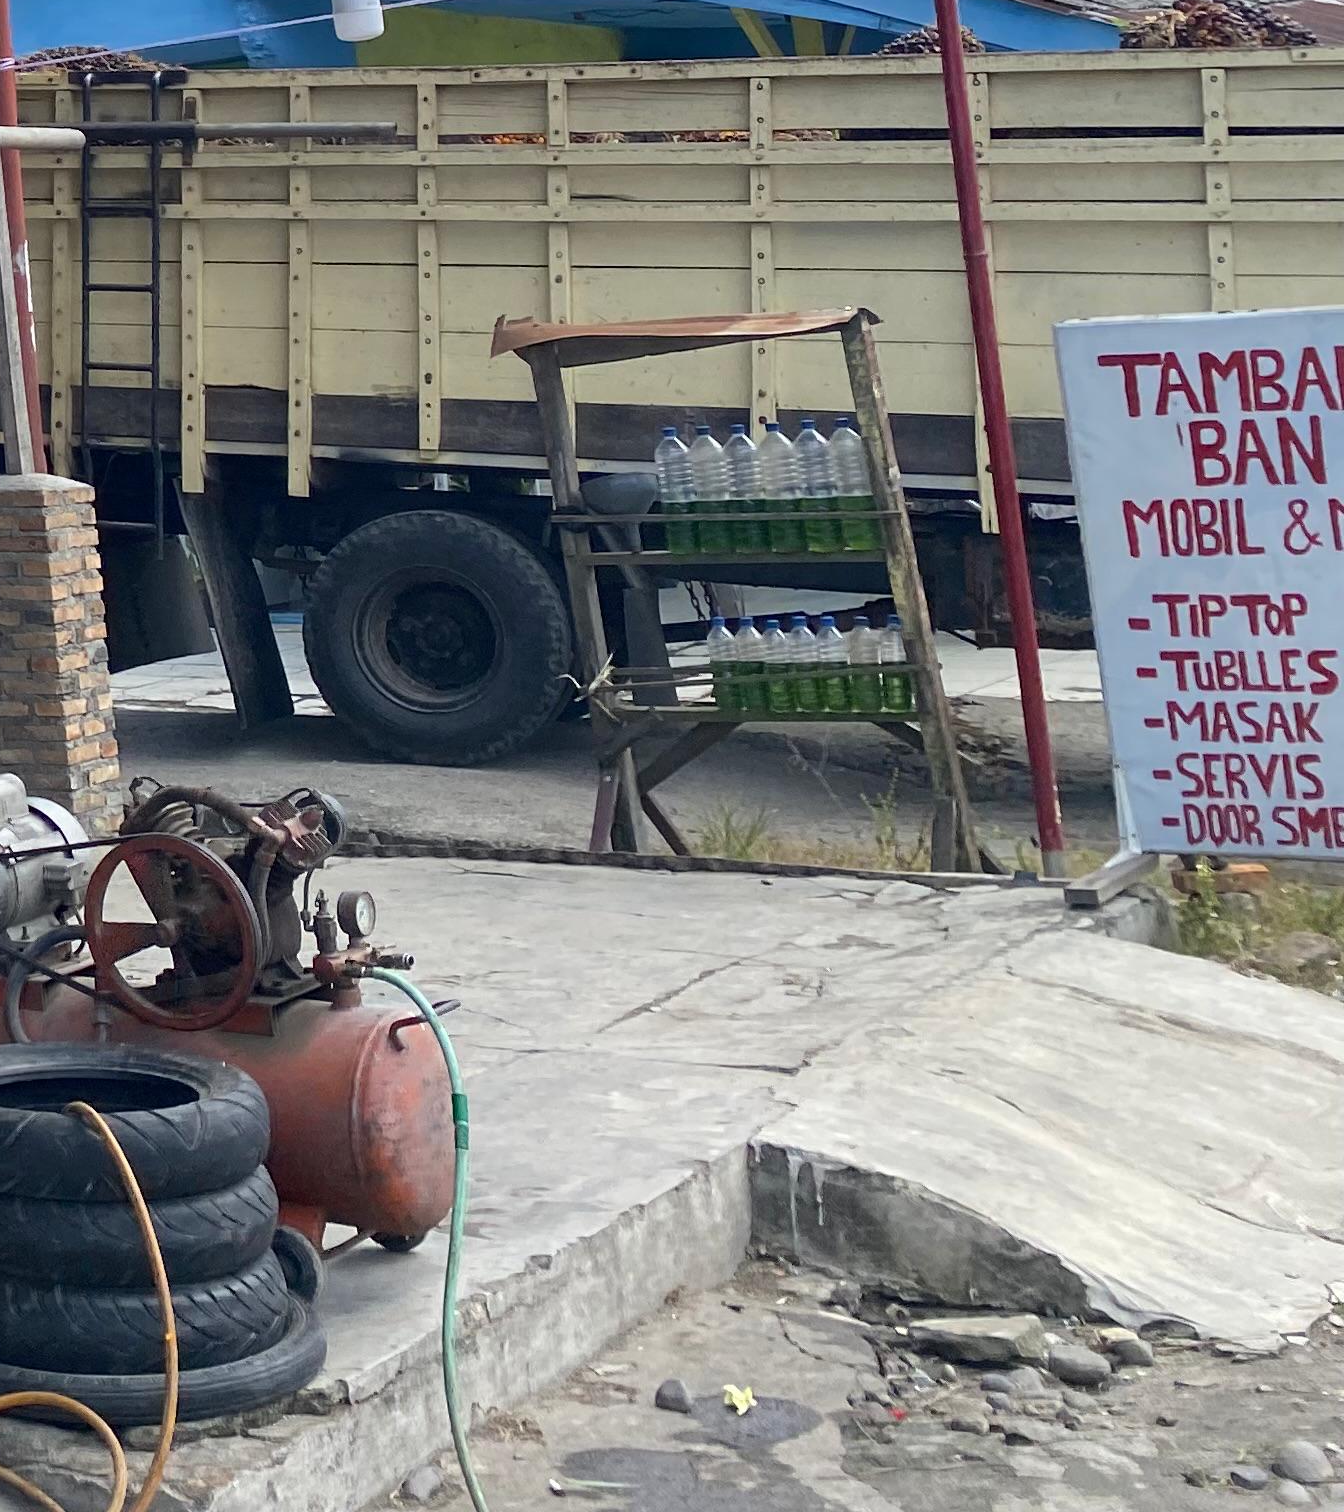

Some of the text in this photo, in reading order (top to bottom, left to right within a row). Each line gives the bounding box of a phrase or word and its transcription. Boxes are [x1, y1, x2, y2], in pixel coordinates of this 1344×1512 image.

[1098, 346, 1344, 417] TAMBA
[1189, 415, 1327, 487] BAN
[1122, 498, 1265, 559] MOBIL
[1284, 498, 1324, 554] &
